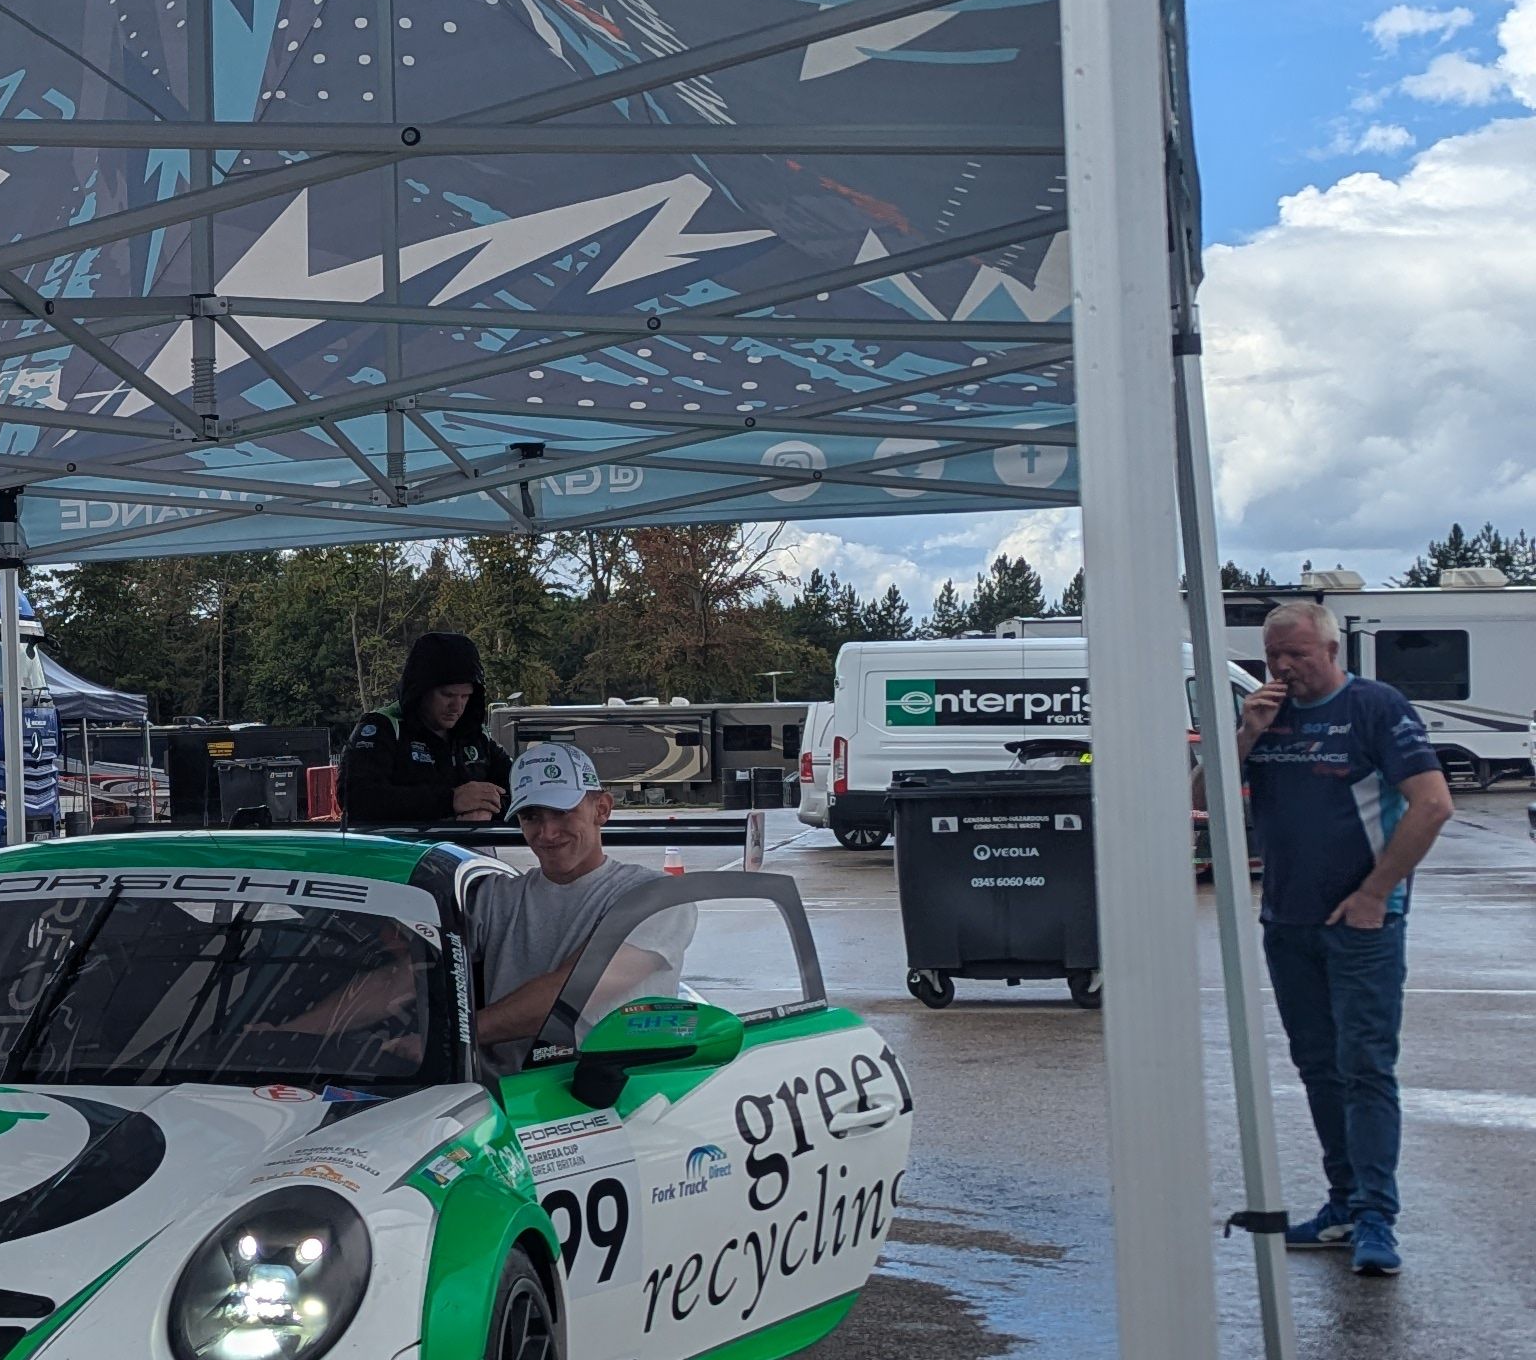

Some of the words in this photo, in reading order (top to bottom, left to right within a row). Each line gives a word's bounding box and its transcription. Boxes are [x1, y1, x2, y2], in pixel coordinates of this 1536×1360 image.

[900, 685, 1092, 720] enterpris
[1046, 712, 1091, 724] rent-
[992, 847, 1040, 858] VEOLIA
[971, 877, 996, 888] 0345
[996, 876, 1024, 887] 6060
[1024, 876, 1046, 887] 460
[446, 932, 472, 1045] www.porsche.co.uk
[518, 1114, 610, 1143] PORSCHE
[526, 1147, 564, 1165] CARRERA
[563, 1143, 579, 1156] CUP
[531, 1161, 556, 1177] GREAT
[556, 1155, 586, 1173] BRITAIN
[651, 1186, 677, 1205] Fork
[677, 1176, 709, 1197] Truck
[708, 1161, 732, 1181] Direct
[540, 1177, 630, 1284] 99
